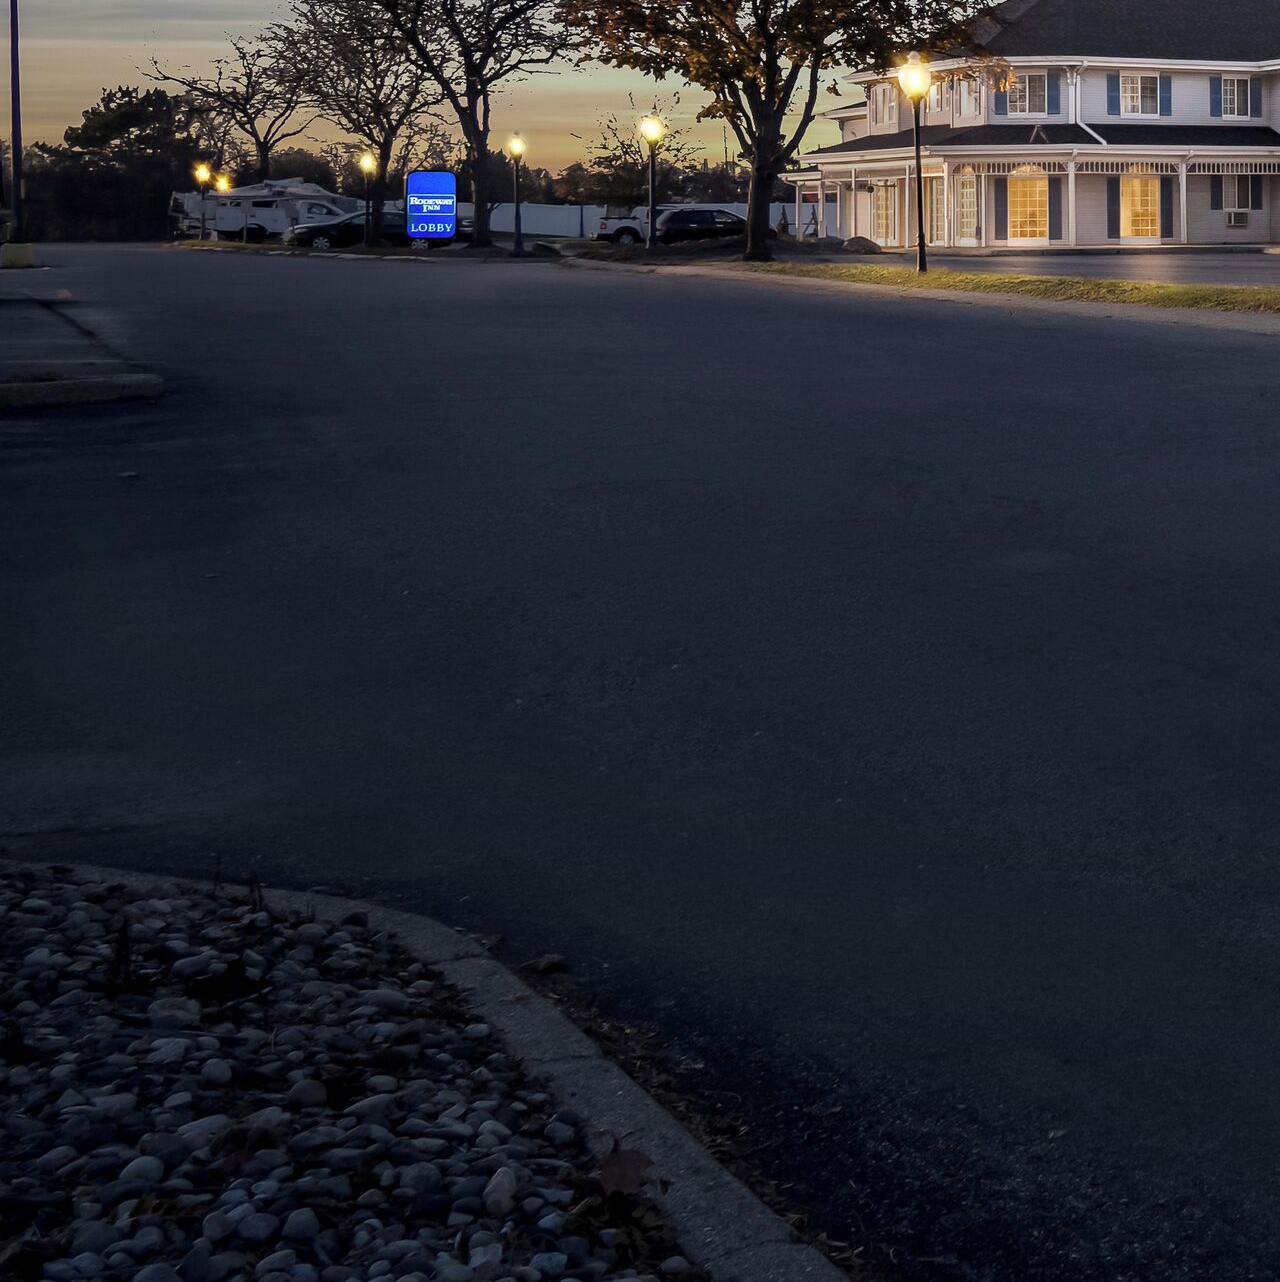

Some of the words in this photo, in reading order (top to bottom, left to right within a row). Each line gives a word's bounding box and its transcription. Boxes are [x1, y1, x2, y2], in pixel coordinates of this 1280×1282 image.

[410, 197, 454, 205] RODEWAY
[423, 204, 441, 212] INN
[411, 223, 453, 232] LOBBY
